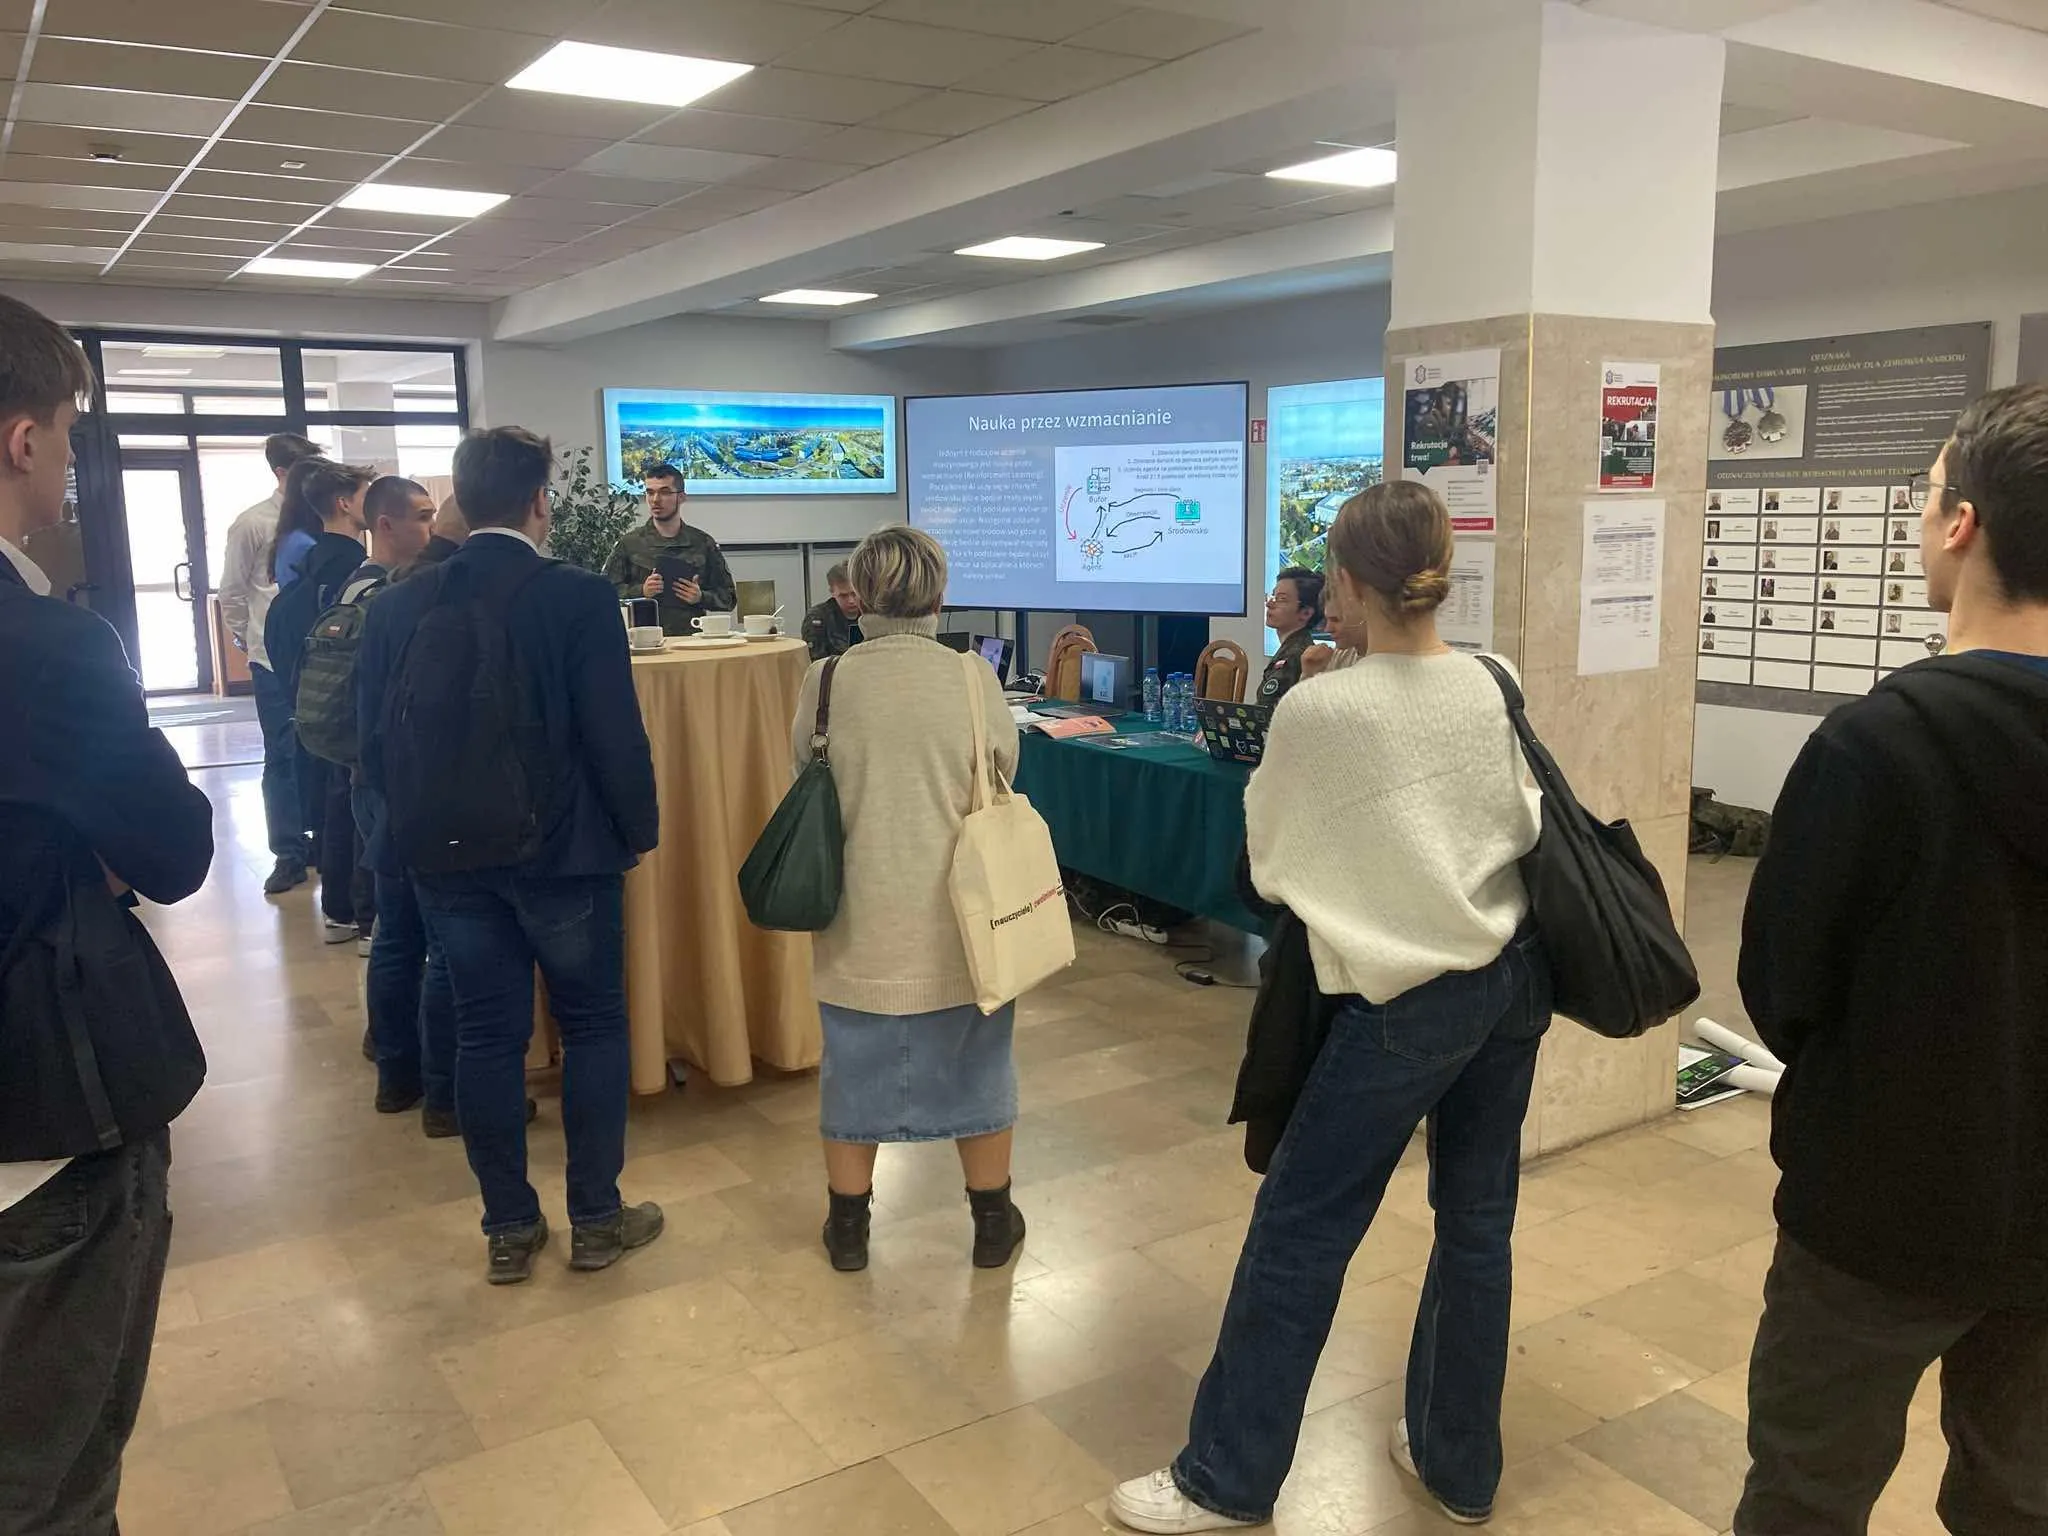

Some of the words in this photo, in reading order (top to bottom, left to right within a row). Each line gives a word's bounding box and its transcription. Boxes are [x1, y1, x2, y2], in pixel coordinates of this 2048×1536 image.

[1607, 395, 1653, 406] REKRUTACJA
[969, 414, 1016, 431] Nauka
[1021, 415, 1061, 432] przez
[1065, 408, 1172, 428] wzmacnianie
[1411, 440, 1448, 450] Rekrutacja
[1411, 453, 1430, 462] trwa!
[1168, 527, 1209, 535] Środowisko
